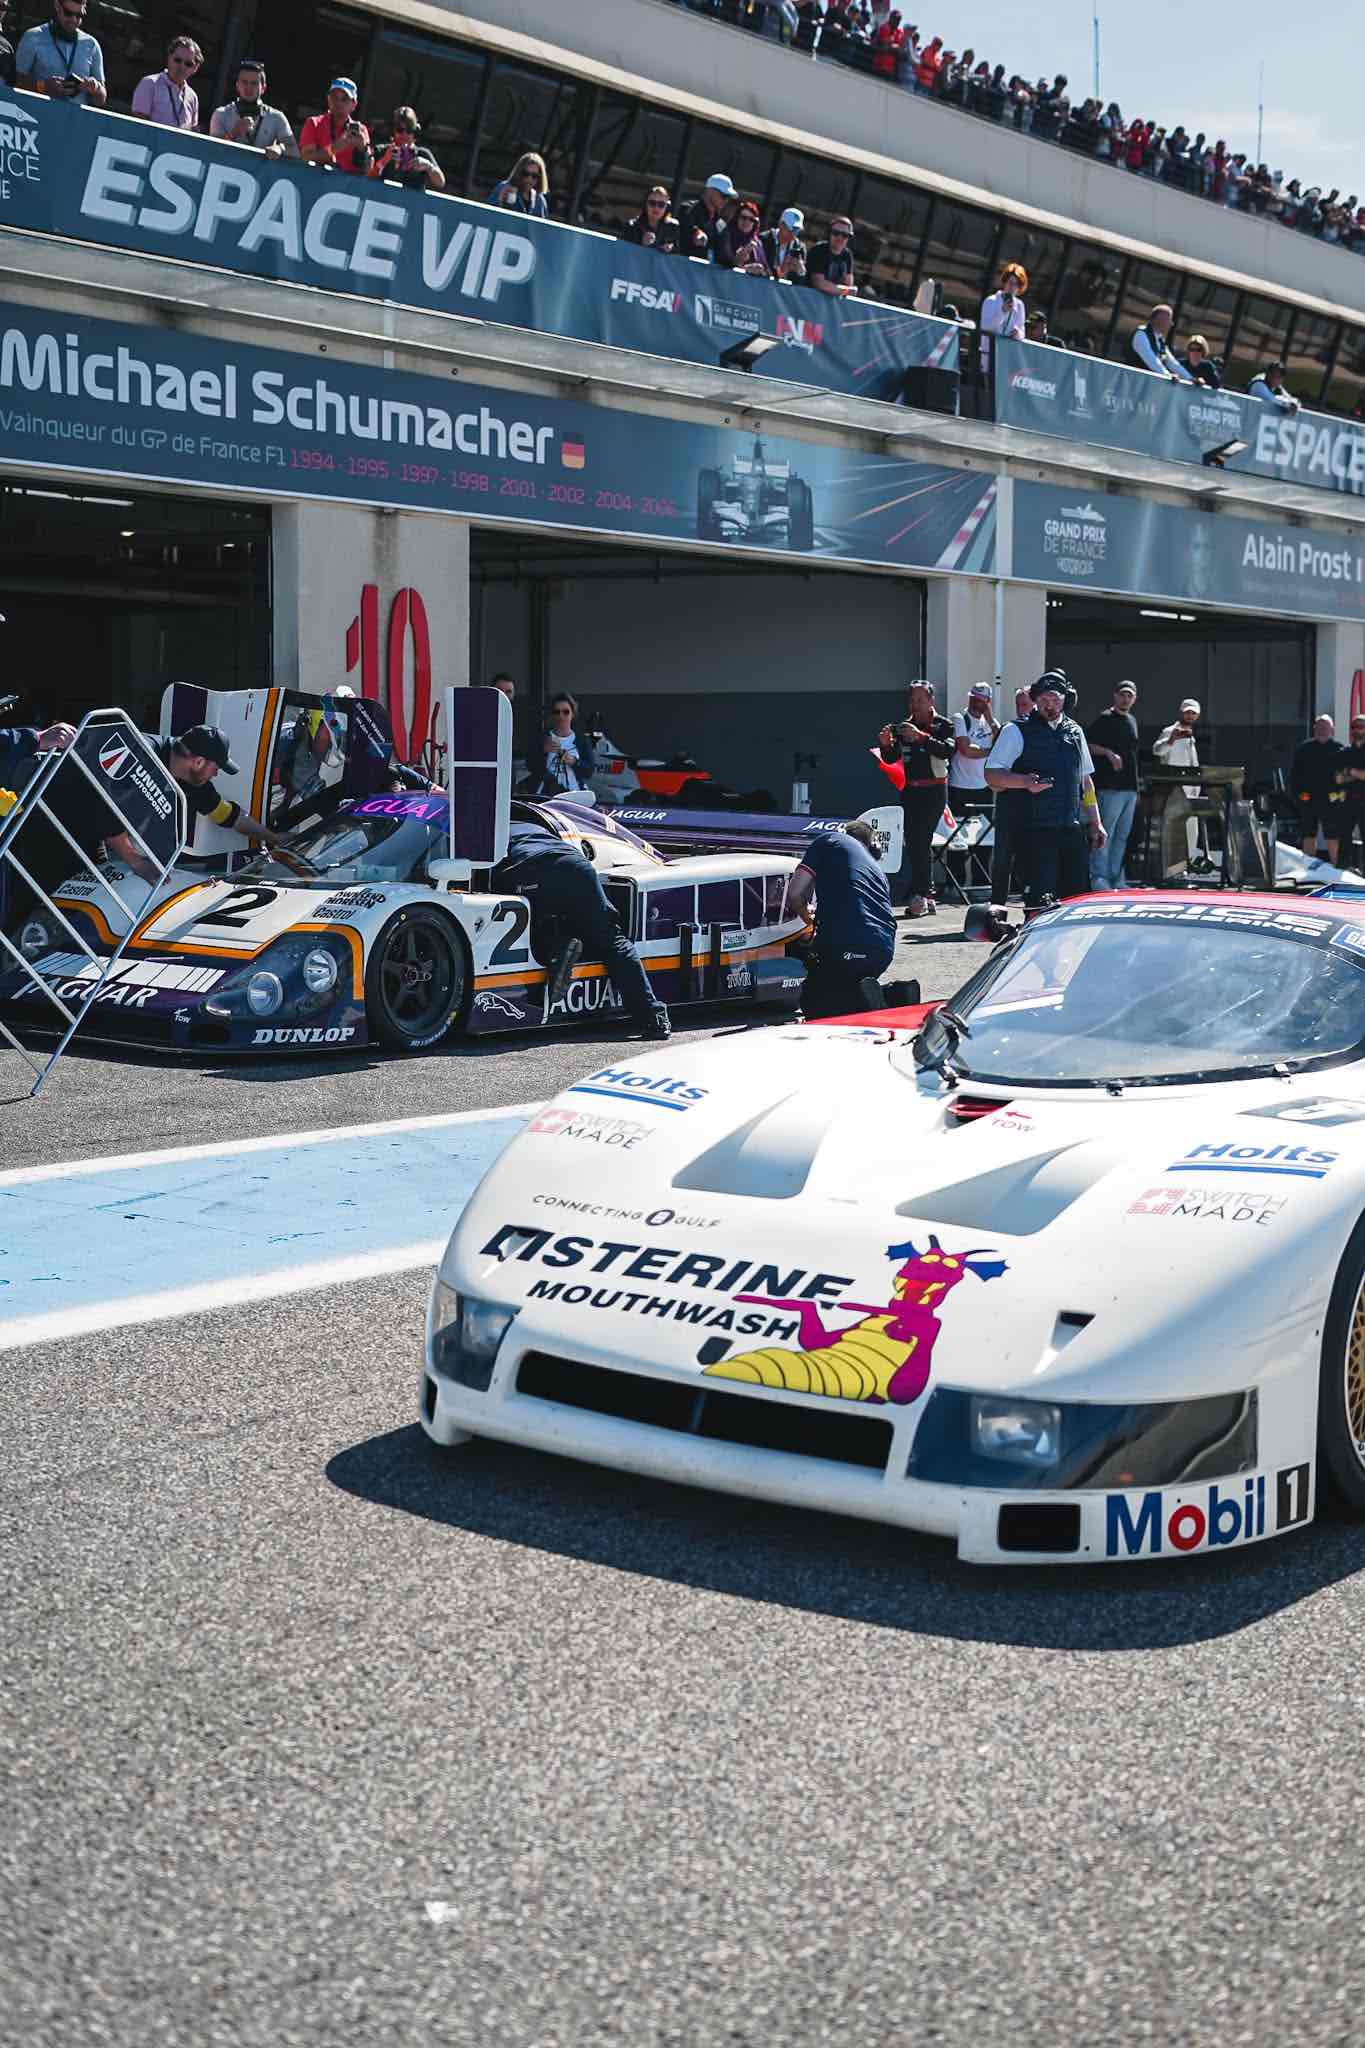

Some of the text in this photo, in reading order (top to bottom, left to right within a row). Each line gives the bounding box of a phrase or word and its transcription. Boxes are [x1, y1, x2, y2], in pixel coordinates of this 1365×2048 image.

[0, 122, 40, 155] RIX
[80, 135, 536, 302] ESPACE VIP
[610, 278, 676, 313] FFSA
[0, 328, 554, 464] Michael Schumacher
[0, 410, 105, 441] Vainqueur
[111, 426, 136, 447] du
[141, 429, 167, 449] GP
[172, 434, 195, 455] de
[200, 437, 262, 463] France
[266, 446, 286, 467] F1
[290, 448, 337, 470] 1994
[348, 456, 390, 479] 1995
[500, 477, 537, 499] 2001
[1255, 414, 1365, 483] ESPACE
[1043, 535, 1107, 560] DE FRANCE
[1044, 519, 1106, 543] GRAND PRIX
[1242, 533, 1352, 582] Alain Prost
[346, 584, 432, 766] 10
[129, 773, 167, 820] AUTOSPORTS
[135, 764, 173, 815] UNITED
[606, 808, 668, 822] JAGUAR
[193, 887, 279, 929] 2
[1063, 912, 1322, 937] ENGINEERING
[1071, 903, 1332, 932] SPICE
[489, 900, 529, 967] 2
[540, 977, 624, 1026] JAGUA
[251, 1027, 355, 1045] DUNLOP
[588, 1068, 710, 1100] Holts
[558, 1125, 643, 1150] MADE
[1183, 1143, 1342, 1164] Holts
[532, 1194, 721, 1229] CONNECTING GULF
[1171, 1203, 1278, 1226] MADE
[1182, 1188, 1289, 1209] SWITCH
[525, 1279, 802, 1342] MOUTHWASH
[1105, 1474, 1266, 1557] Mobil
